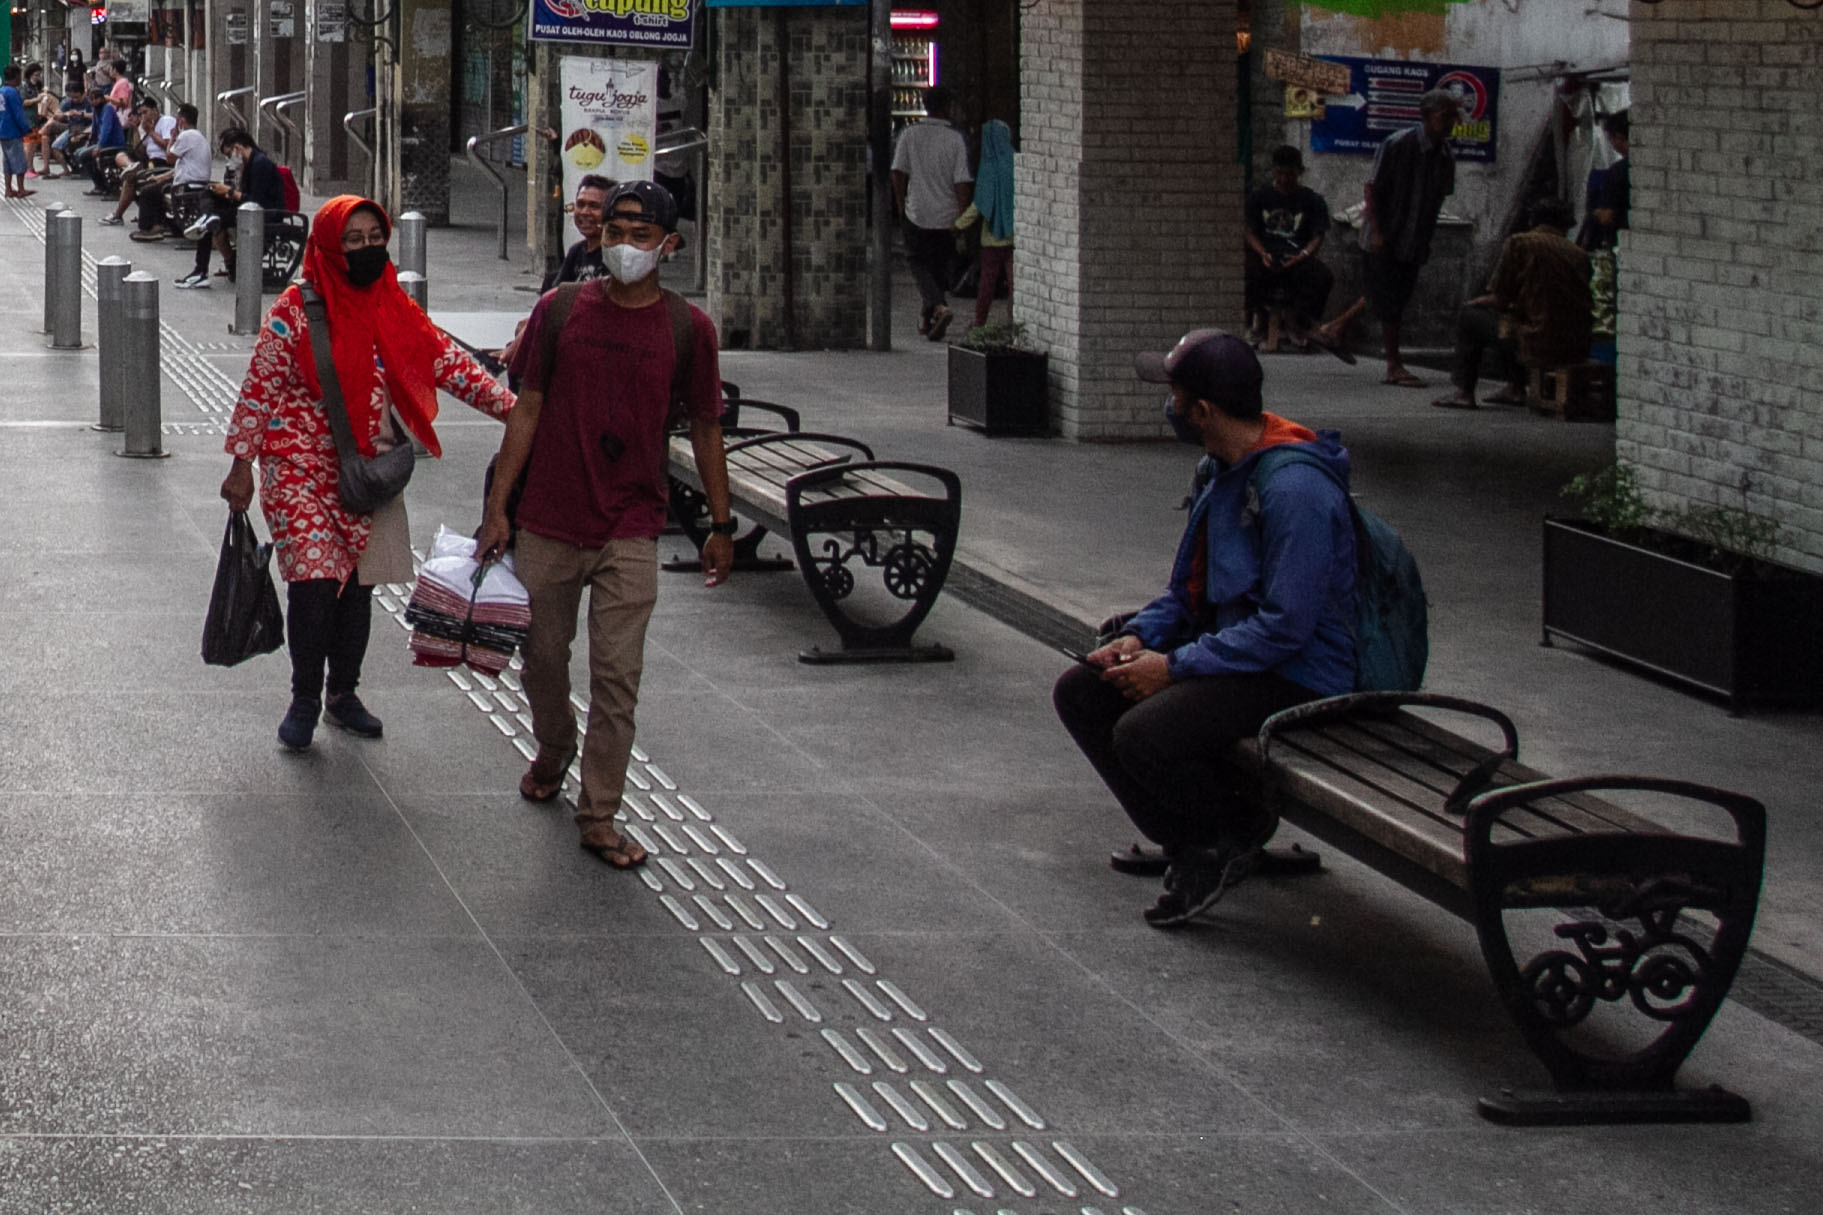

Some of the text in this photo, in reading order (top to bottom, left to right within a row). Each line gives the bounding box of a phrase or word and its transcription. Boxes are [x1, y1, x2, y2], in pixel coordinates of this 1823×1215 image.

[535, 24, 560, 35] PUSAT
[606, 27, 628, 39] KAOS
[662, 31, 688, 43] JOGJA
[569, 85, 648, 108] tugu jogja
